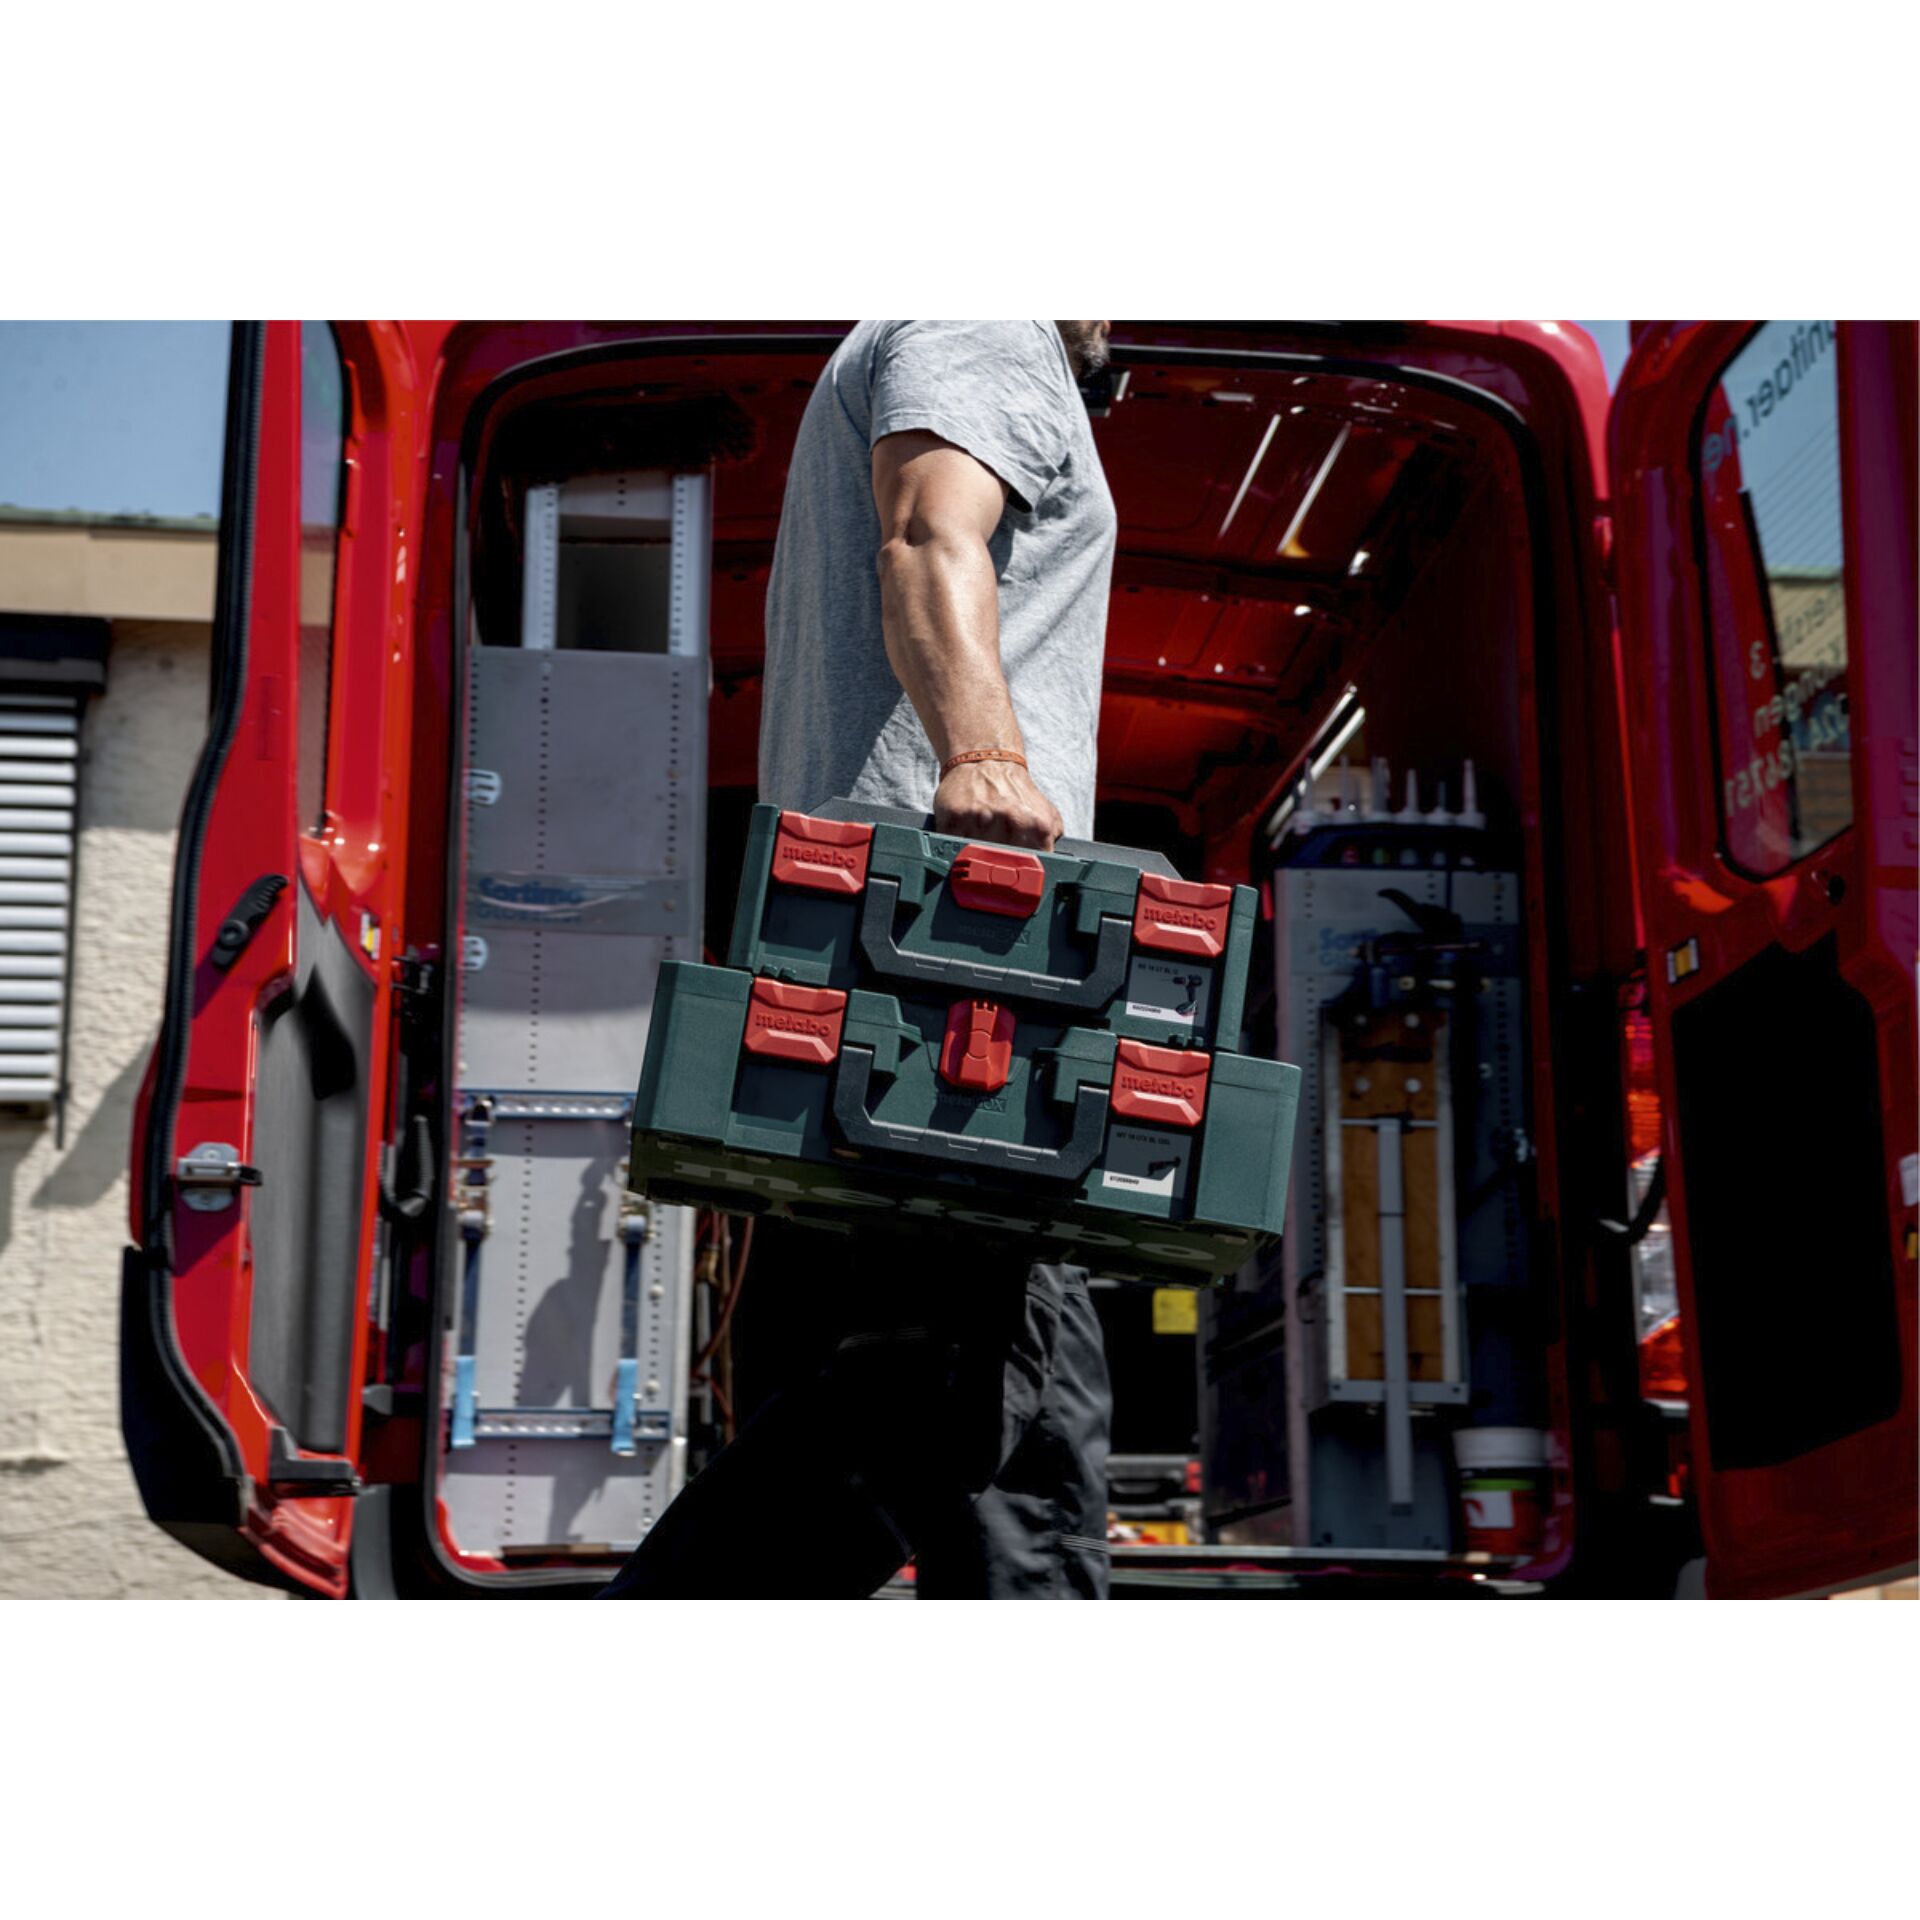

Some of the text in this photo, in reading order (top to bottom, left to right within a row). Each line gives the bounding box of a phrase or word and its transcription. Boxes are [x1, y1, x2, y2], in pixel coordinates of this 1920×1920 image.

[782, 845, 857, 870] metabo
[1143, 907, 1217, 932] metabo
[755, 1011, 832, 1038] metabo
[1121, 1074, 1196, 1100] metabo
[674, 1159, 1218, 1262] metabo
